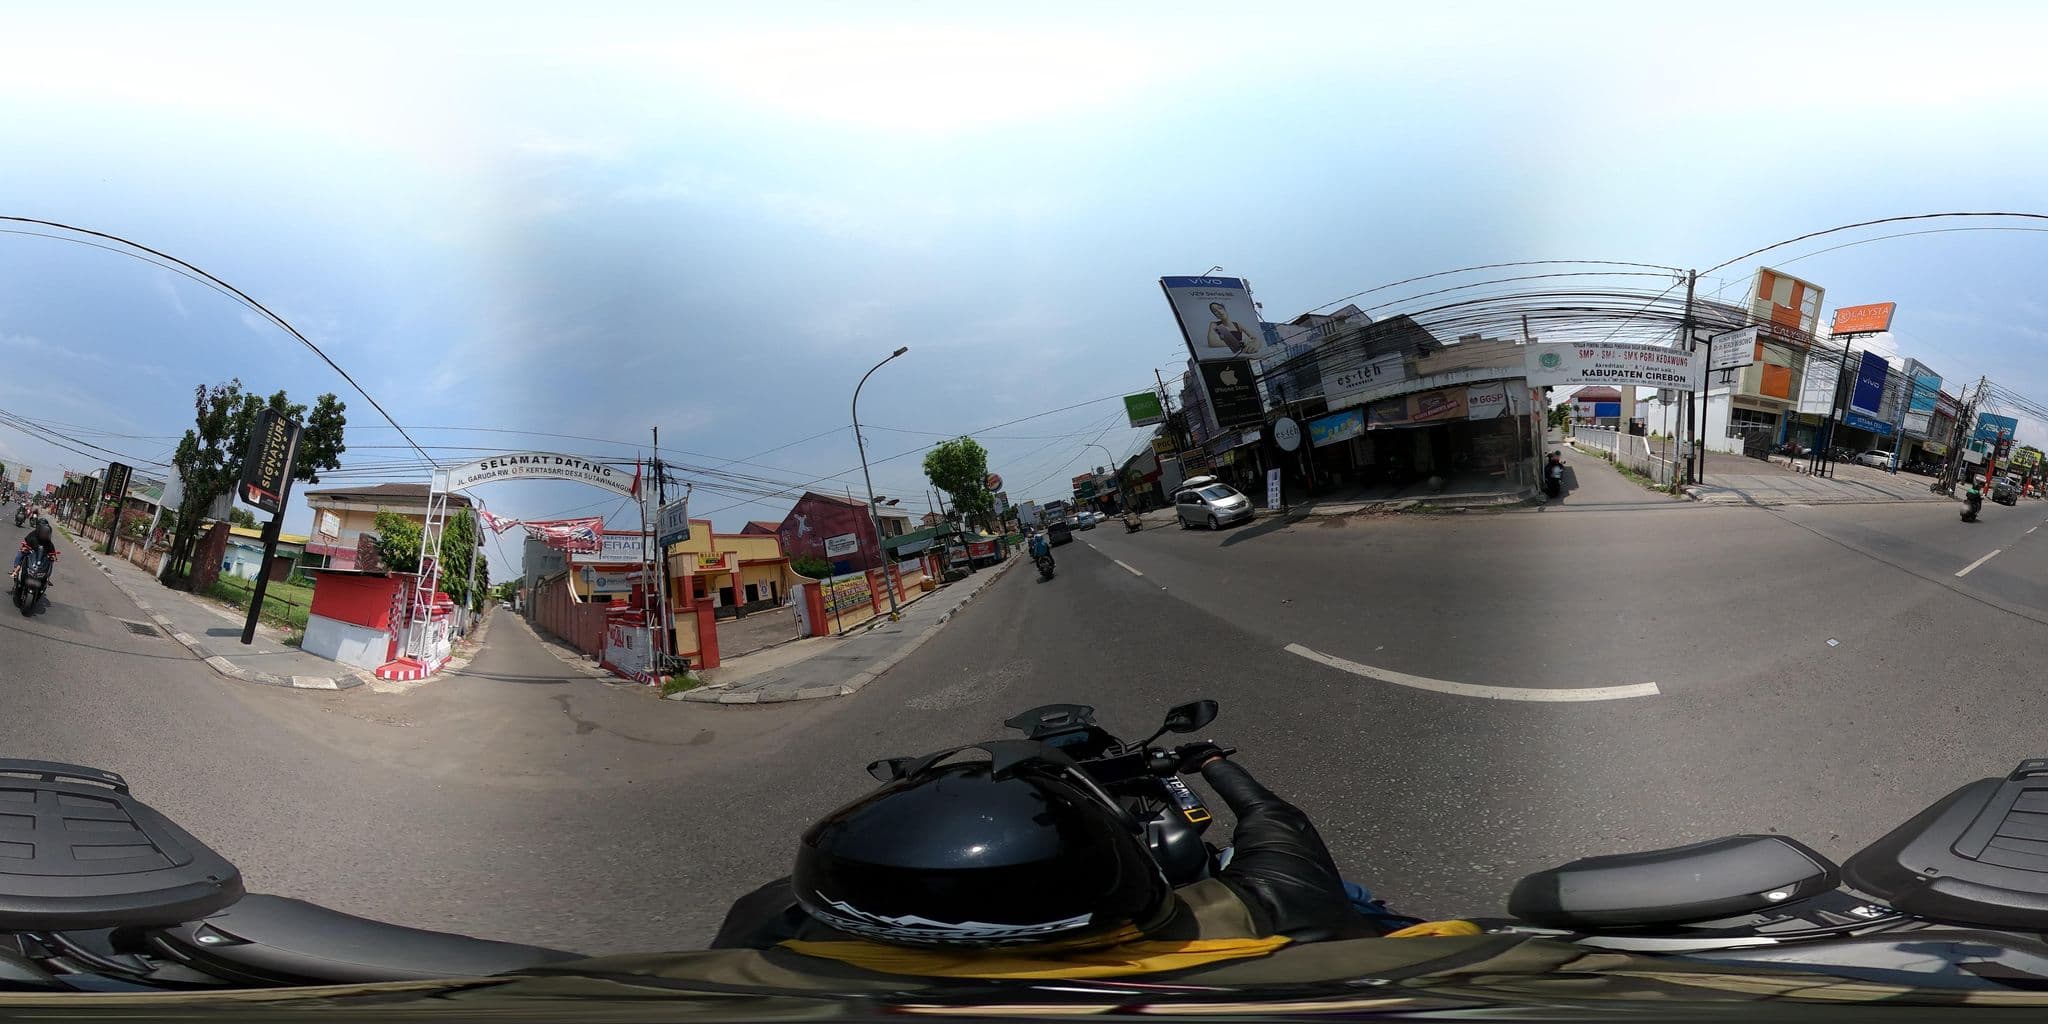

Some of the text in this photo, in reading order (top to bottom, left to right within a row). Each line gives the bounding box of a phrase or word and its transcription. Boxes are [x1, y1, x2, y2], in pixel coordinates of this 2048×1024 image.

[1579, 349, 1594, 359] SMP
[1639, 352, 1655, 362] PGRI
[1656, 353, 1688, 367] KEDAWUNG
[1582, 369, 1643, 379] KABUPATEN
[1646, 372, 1686, 383] CIREBON
[1480, 393, 1504, 404] GGSP
[262, 417, 286, 488] SIGNATURE
[468, 471, 498, 483] GARUDA
[526, 466, 564, 476] KERTASARI
[565, 469, 583, 479] DESA
[480, 455, 612, 477] SELAMAT DATANG
